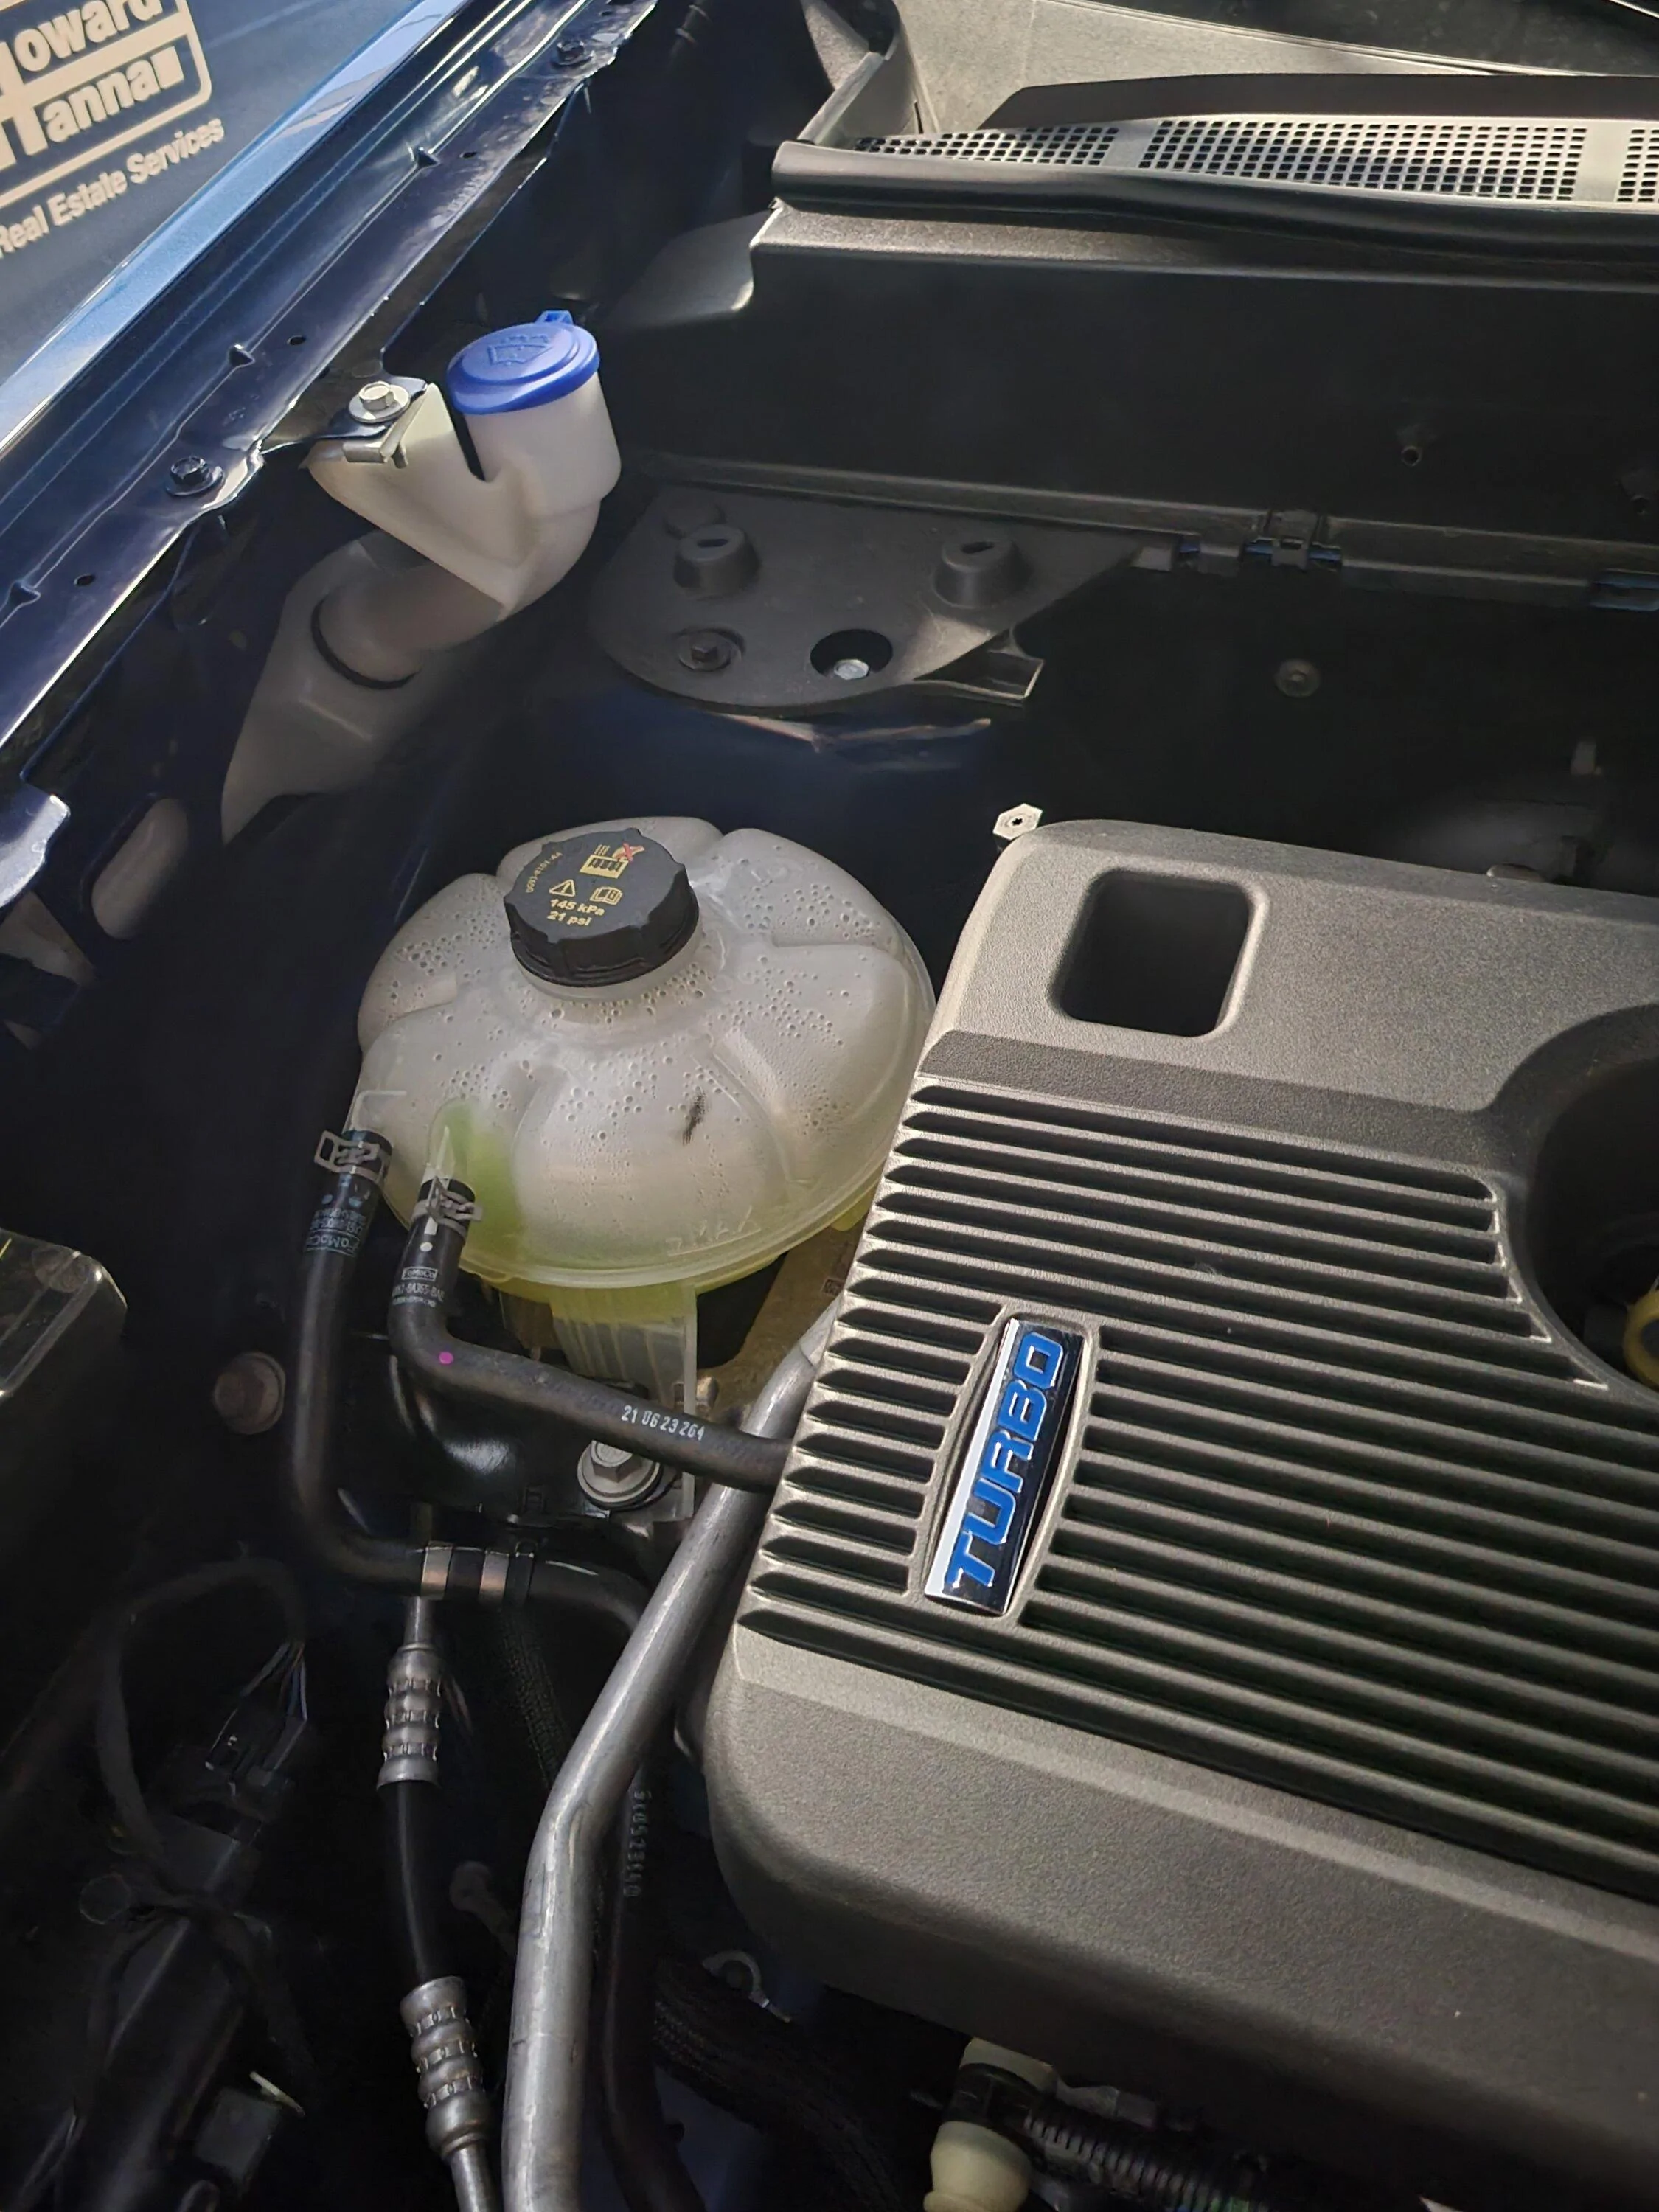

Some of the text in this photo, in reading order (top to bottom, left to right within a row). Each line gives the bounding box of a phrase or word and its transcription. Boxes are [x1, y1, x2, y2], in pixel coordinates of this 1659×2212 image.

[46, 170, 128, 226] Estate
[126, 118, 224, 184] Services
[550, 899, 605, 917] 145 kPa
[547, 911, 592, 926] 21 psi
[621, 1405, 638, 1424] 21
[944, 1331, 1064, 1588] TURBO
